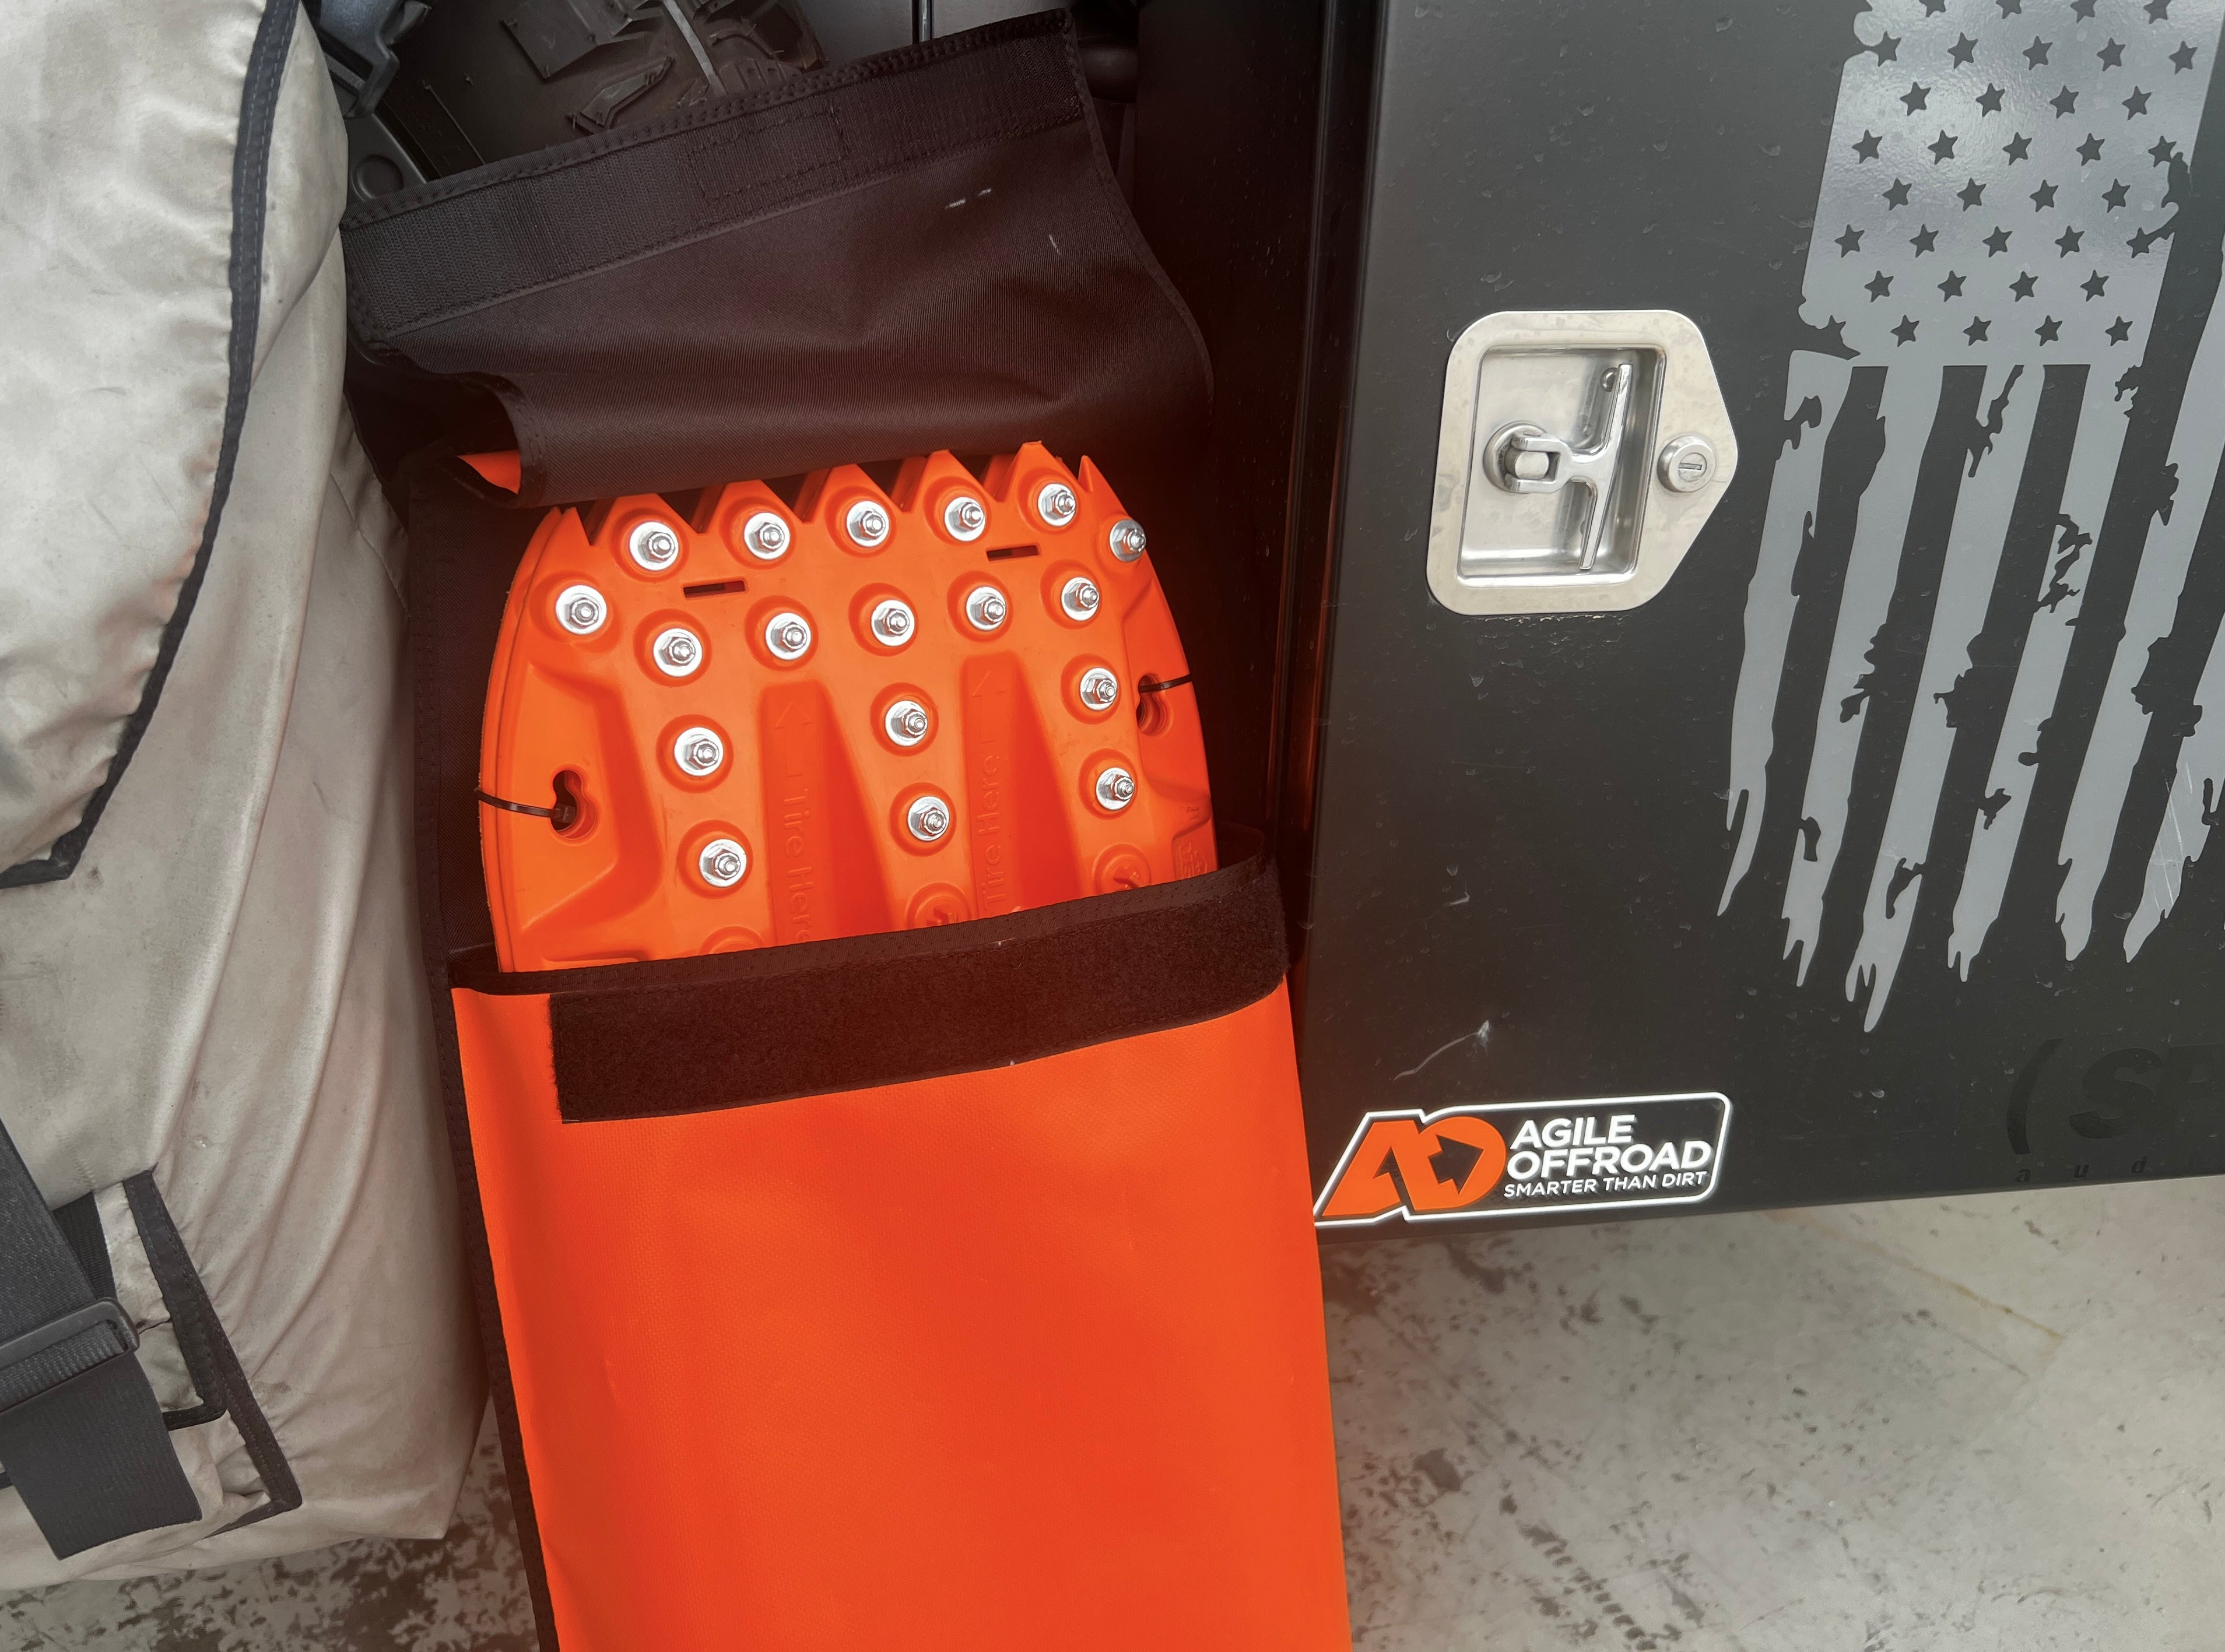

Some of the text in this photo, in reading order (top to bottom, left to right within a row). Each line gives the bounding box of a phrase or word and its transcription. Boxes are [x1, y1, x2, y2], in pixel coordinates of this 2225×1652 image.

[784, 788, 811, 857] Tire
[977, 755, 1007, 911] Tire Here
[1510, 1114, 1636, 1150] AGILE
[1507, 1140, 1712, 1180] OFFROAD
[1504, 1171, 1707, 1197] SMARTER THAN DIRT
